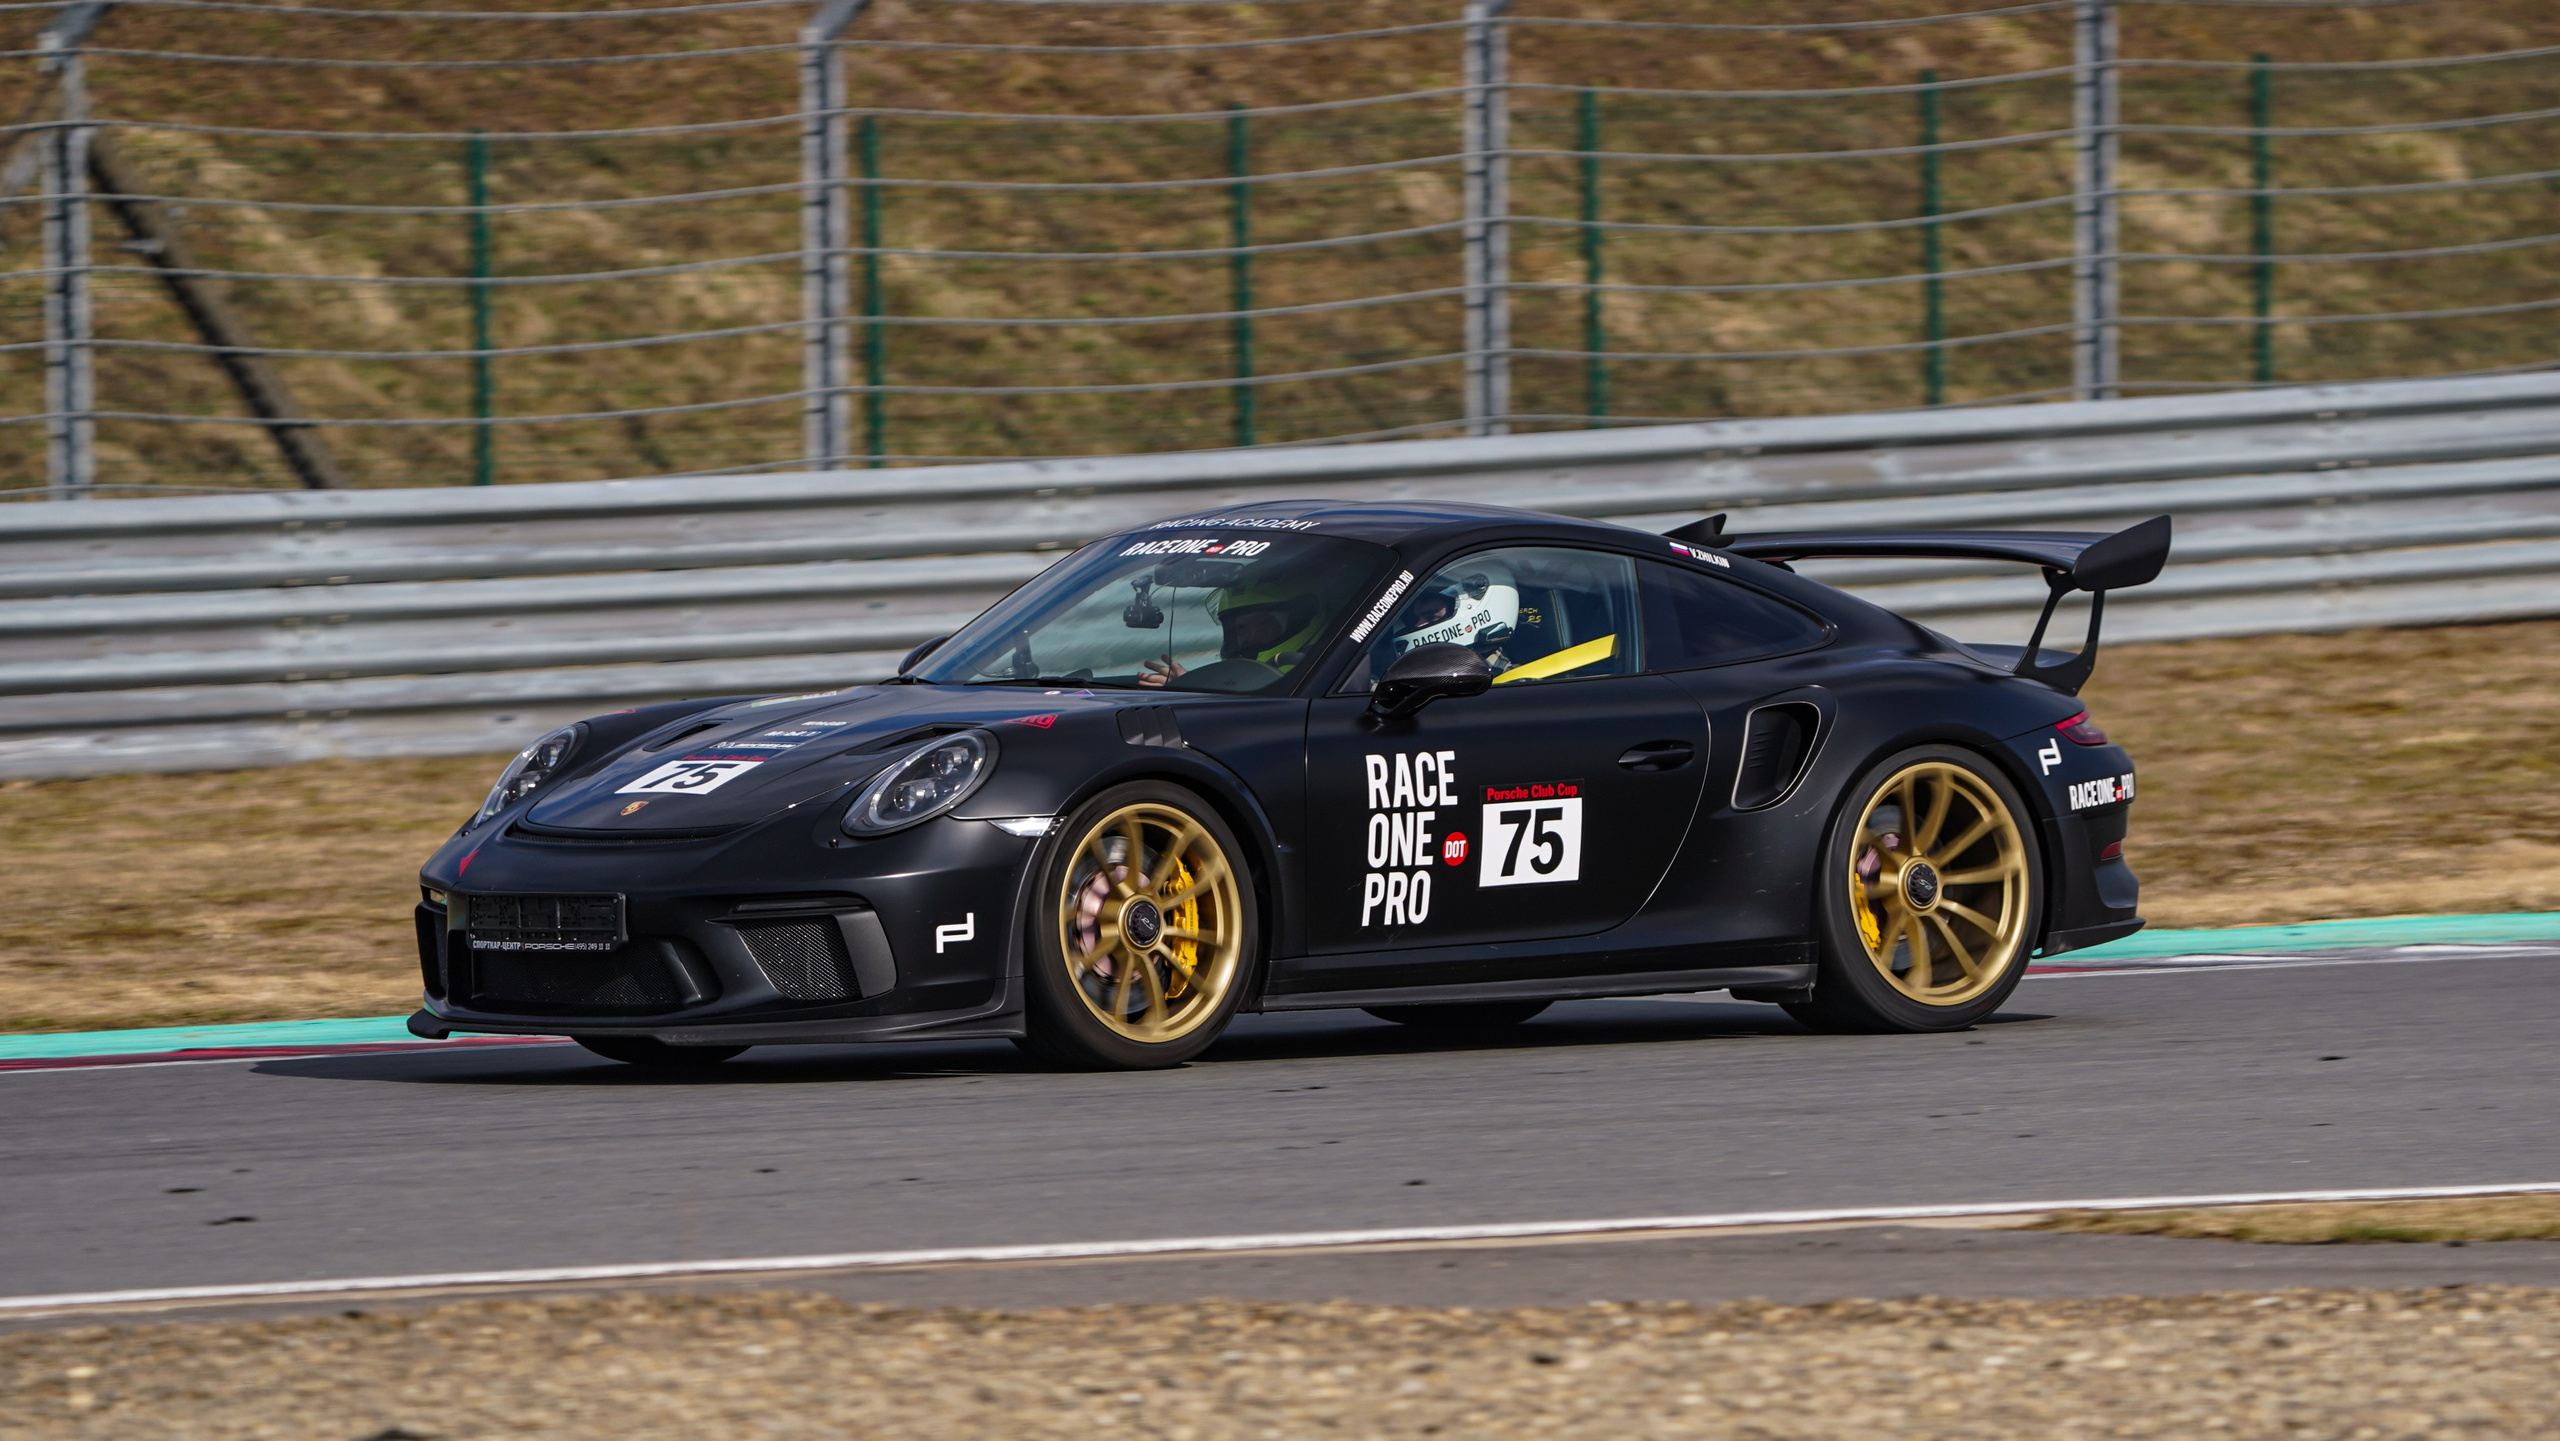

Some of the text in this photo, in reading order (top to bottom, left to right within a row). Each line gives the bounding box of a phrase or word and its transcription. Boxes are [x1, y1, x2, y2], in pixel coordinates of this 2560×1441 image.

[1149, 518, 1321, 531] RACING ACADEMY
[1119, 539, 1219, 557] RACEONE
[1219, 540, 1270, 557] PRO
[1350, 570, 1414, 643] WWW.RACEONEPRO.RU
[1471, 609, 1491, 629] PRO
[639, 763, 741, 789] 75
[1365, 750, 1458, 809] RACE
[1487, 783, 1578, 801] Porsche Club Cup
[2068, 777, 2116, 811] RACEONE
[1367, 811, 1436, 869] ONE
[1445, 840, 1466, 859] DOT
[1500, 806, 1564, 877] 75
[1361, 870, 1431, 927] PRO
[1141, 917, 1155, 931] RS
[473, 940, 521, 950] СПОРТКАР-ЦЕНТР
